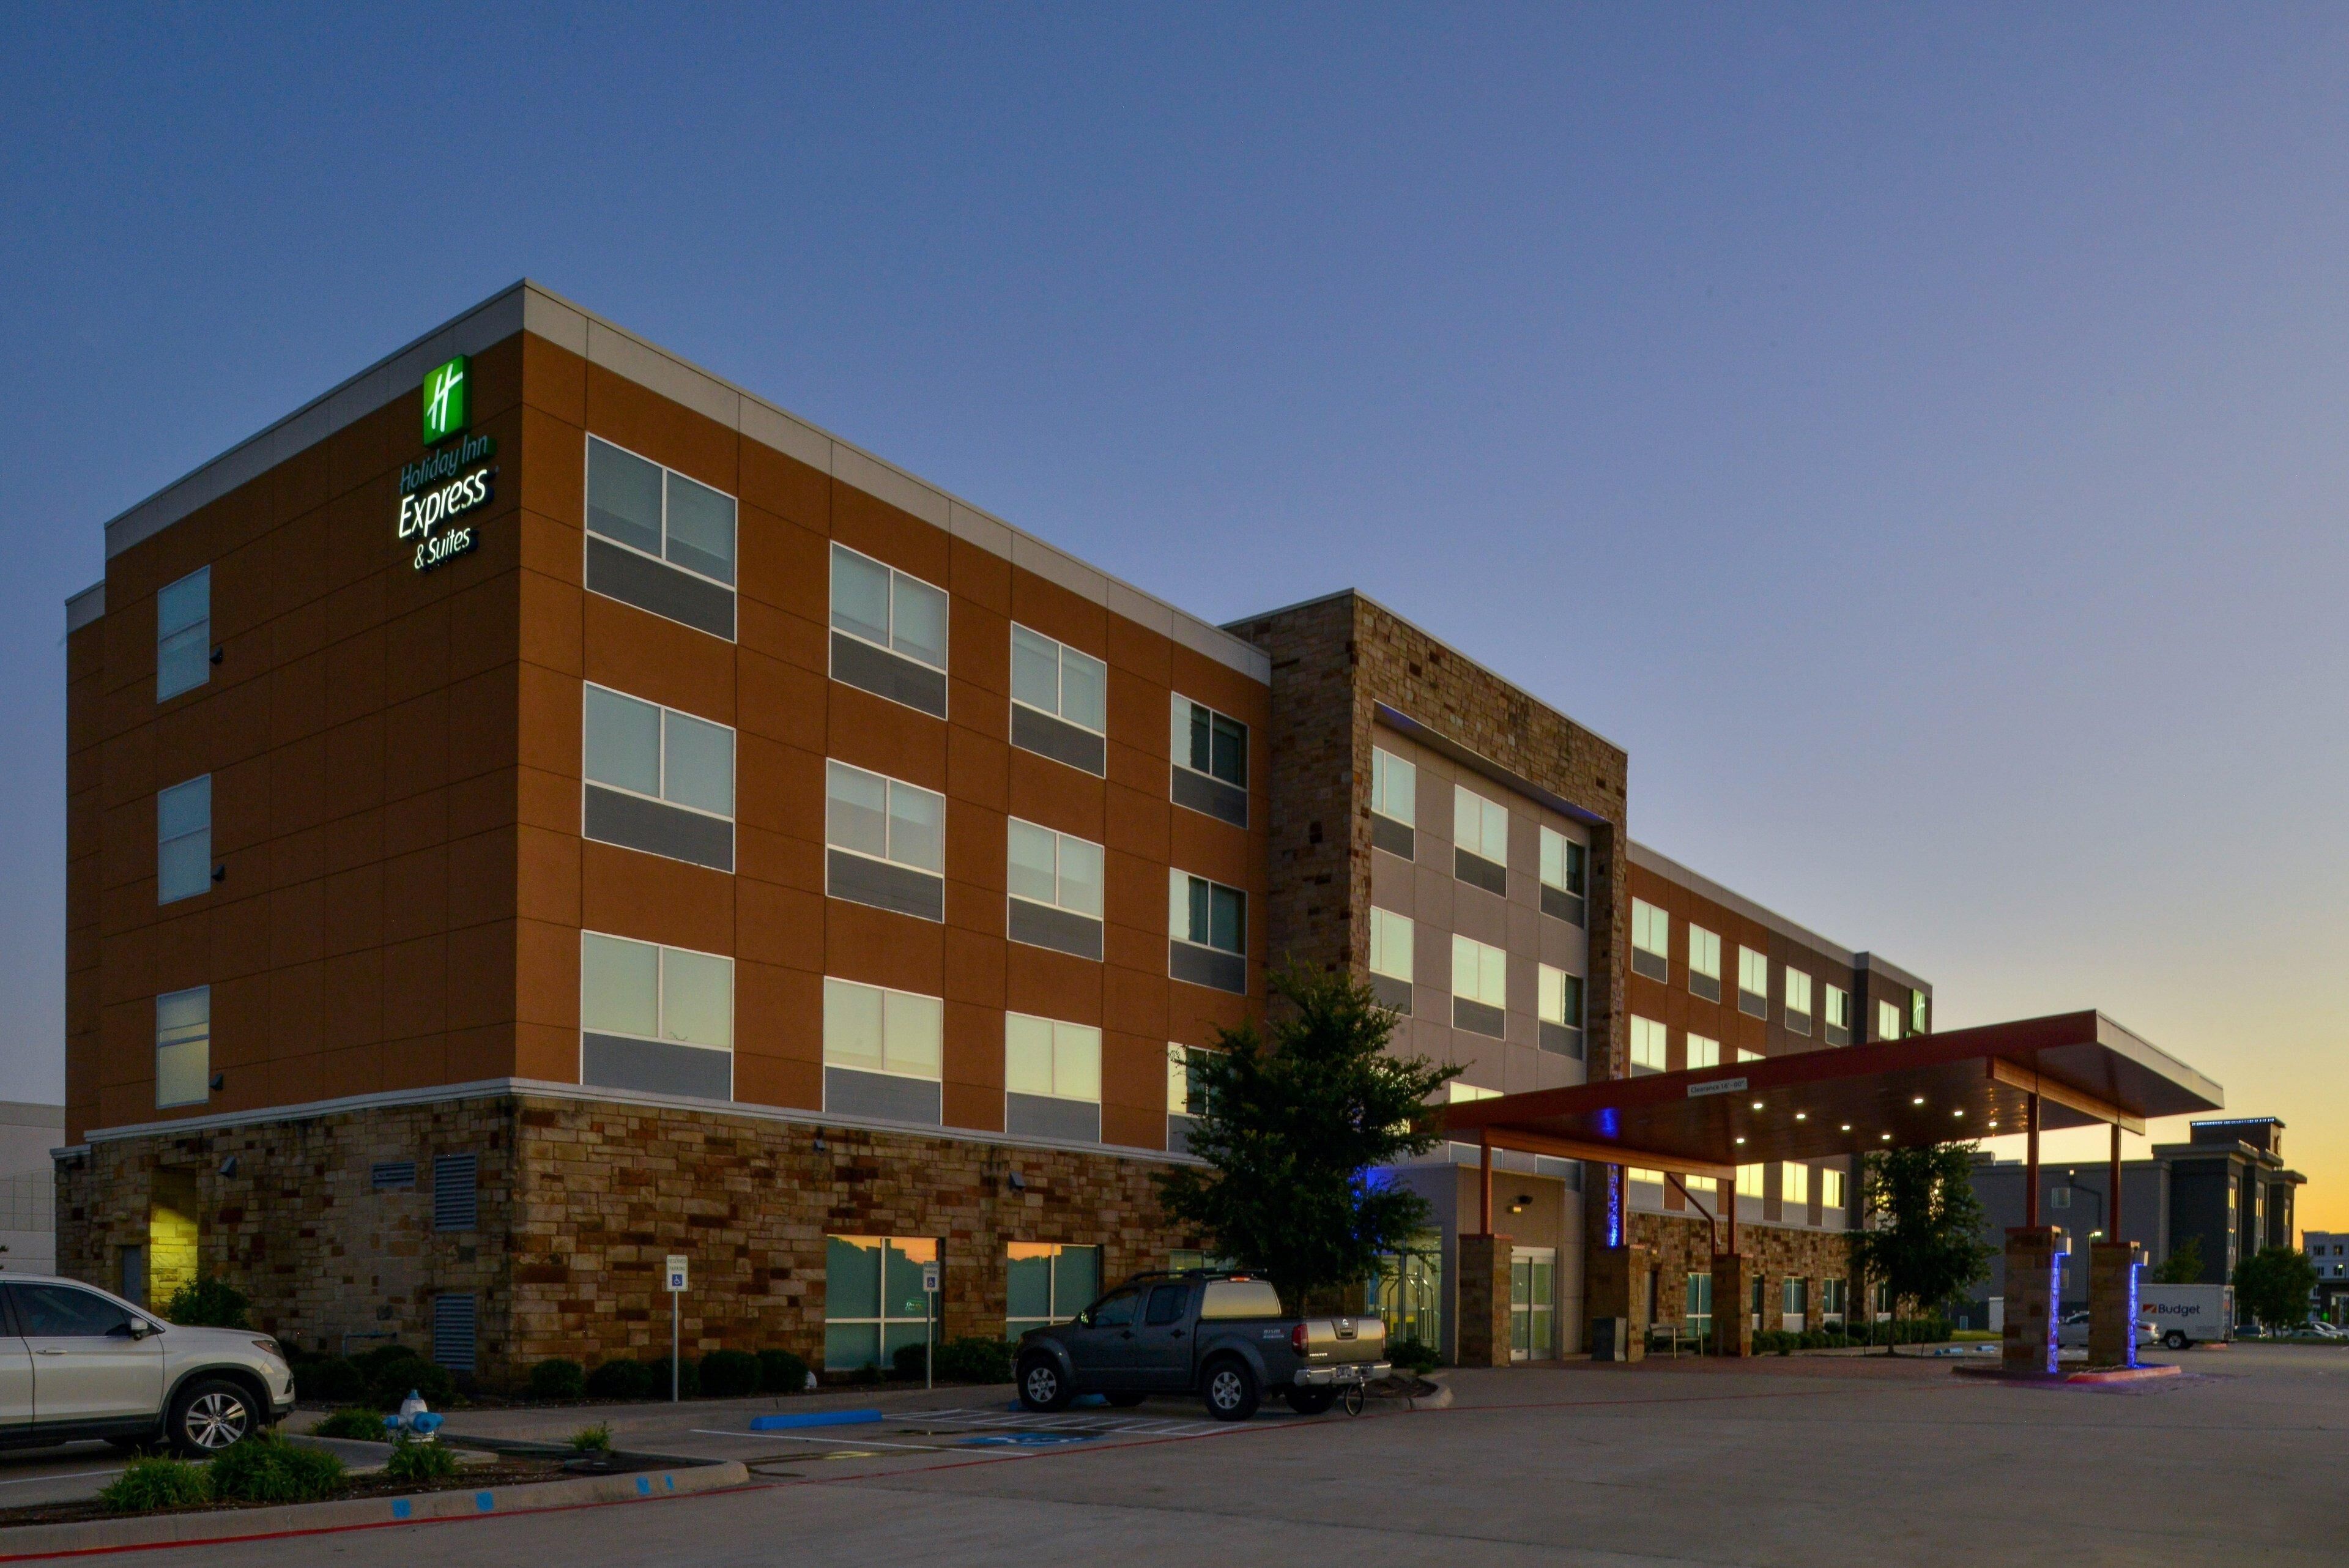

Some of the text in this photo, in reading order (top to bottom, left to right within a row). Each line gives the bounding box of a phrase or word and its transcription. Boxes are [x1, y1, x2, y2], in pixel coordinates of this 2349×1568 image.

[399, 434, 488, 495] Holiday Inn
[398, 469, 488, 539] Express
[414, 527, 470, 570] & Suites
[2158, 1304, 2200, 1317] Budget
